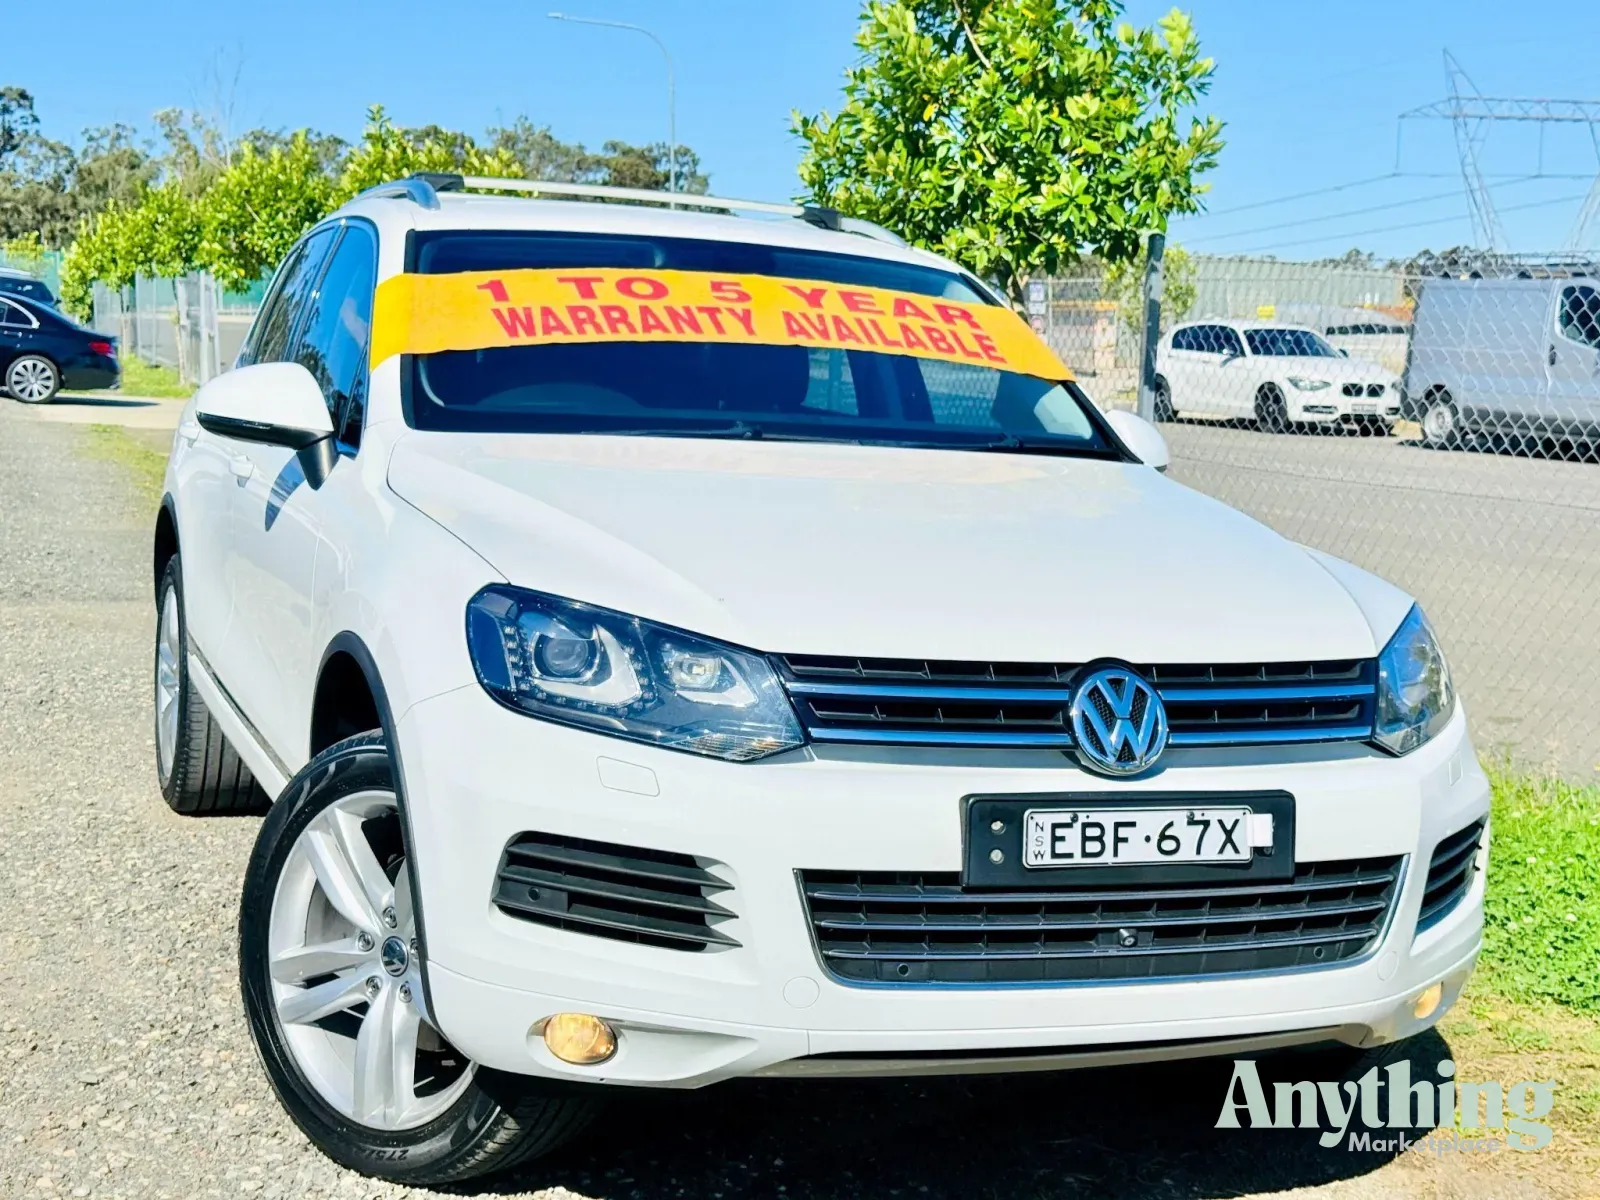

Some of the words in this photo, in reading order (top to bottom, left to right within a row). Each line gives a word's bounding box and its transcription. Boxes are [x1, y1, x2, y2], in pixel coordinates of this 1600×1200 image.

[476, 279, 509, 302] 1
[557, 277, 669, 301] TO
[710, 280, 752, 303] 5
[782, 285, 983, 331] YEAR
[491, 305, 757, 338] WARRANTY
[782, 311, 1007, 364] AVAILABLE
